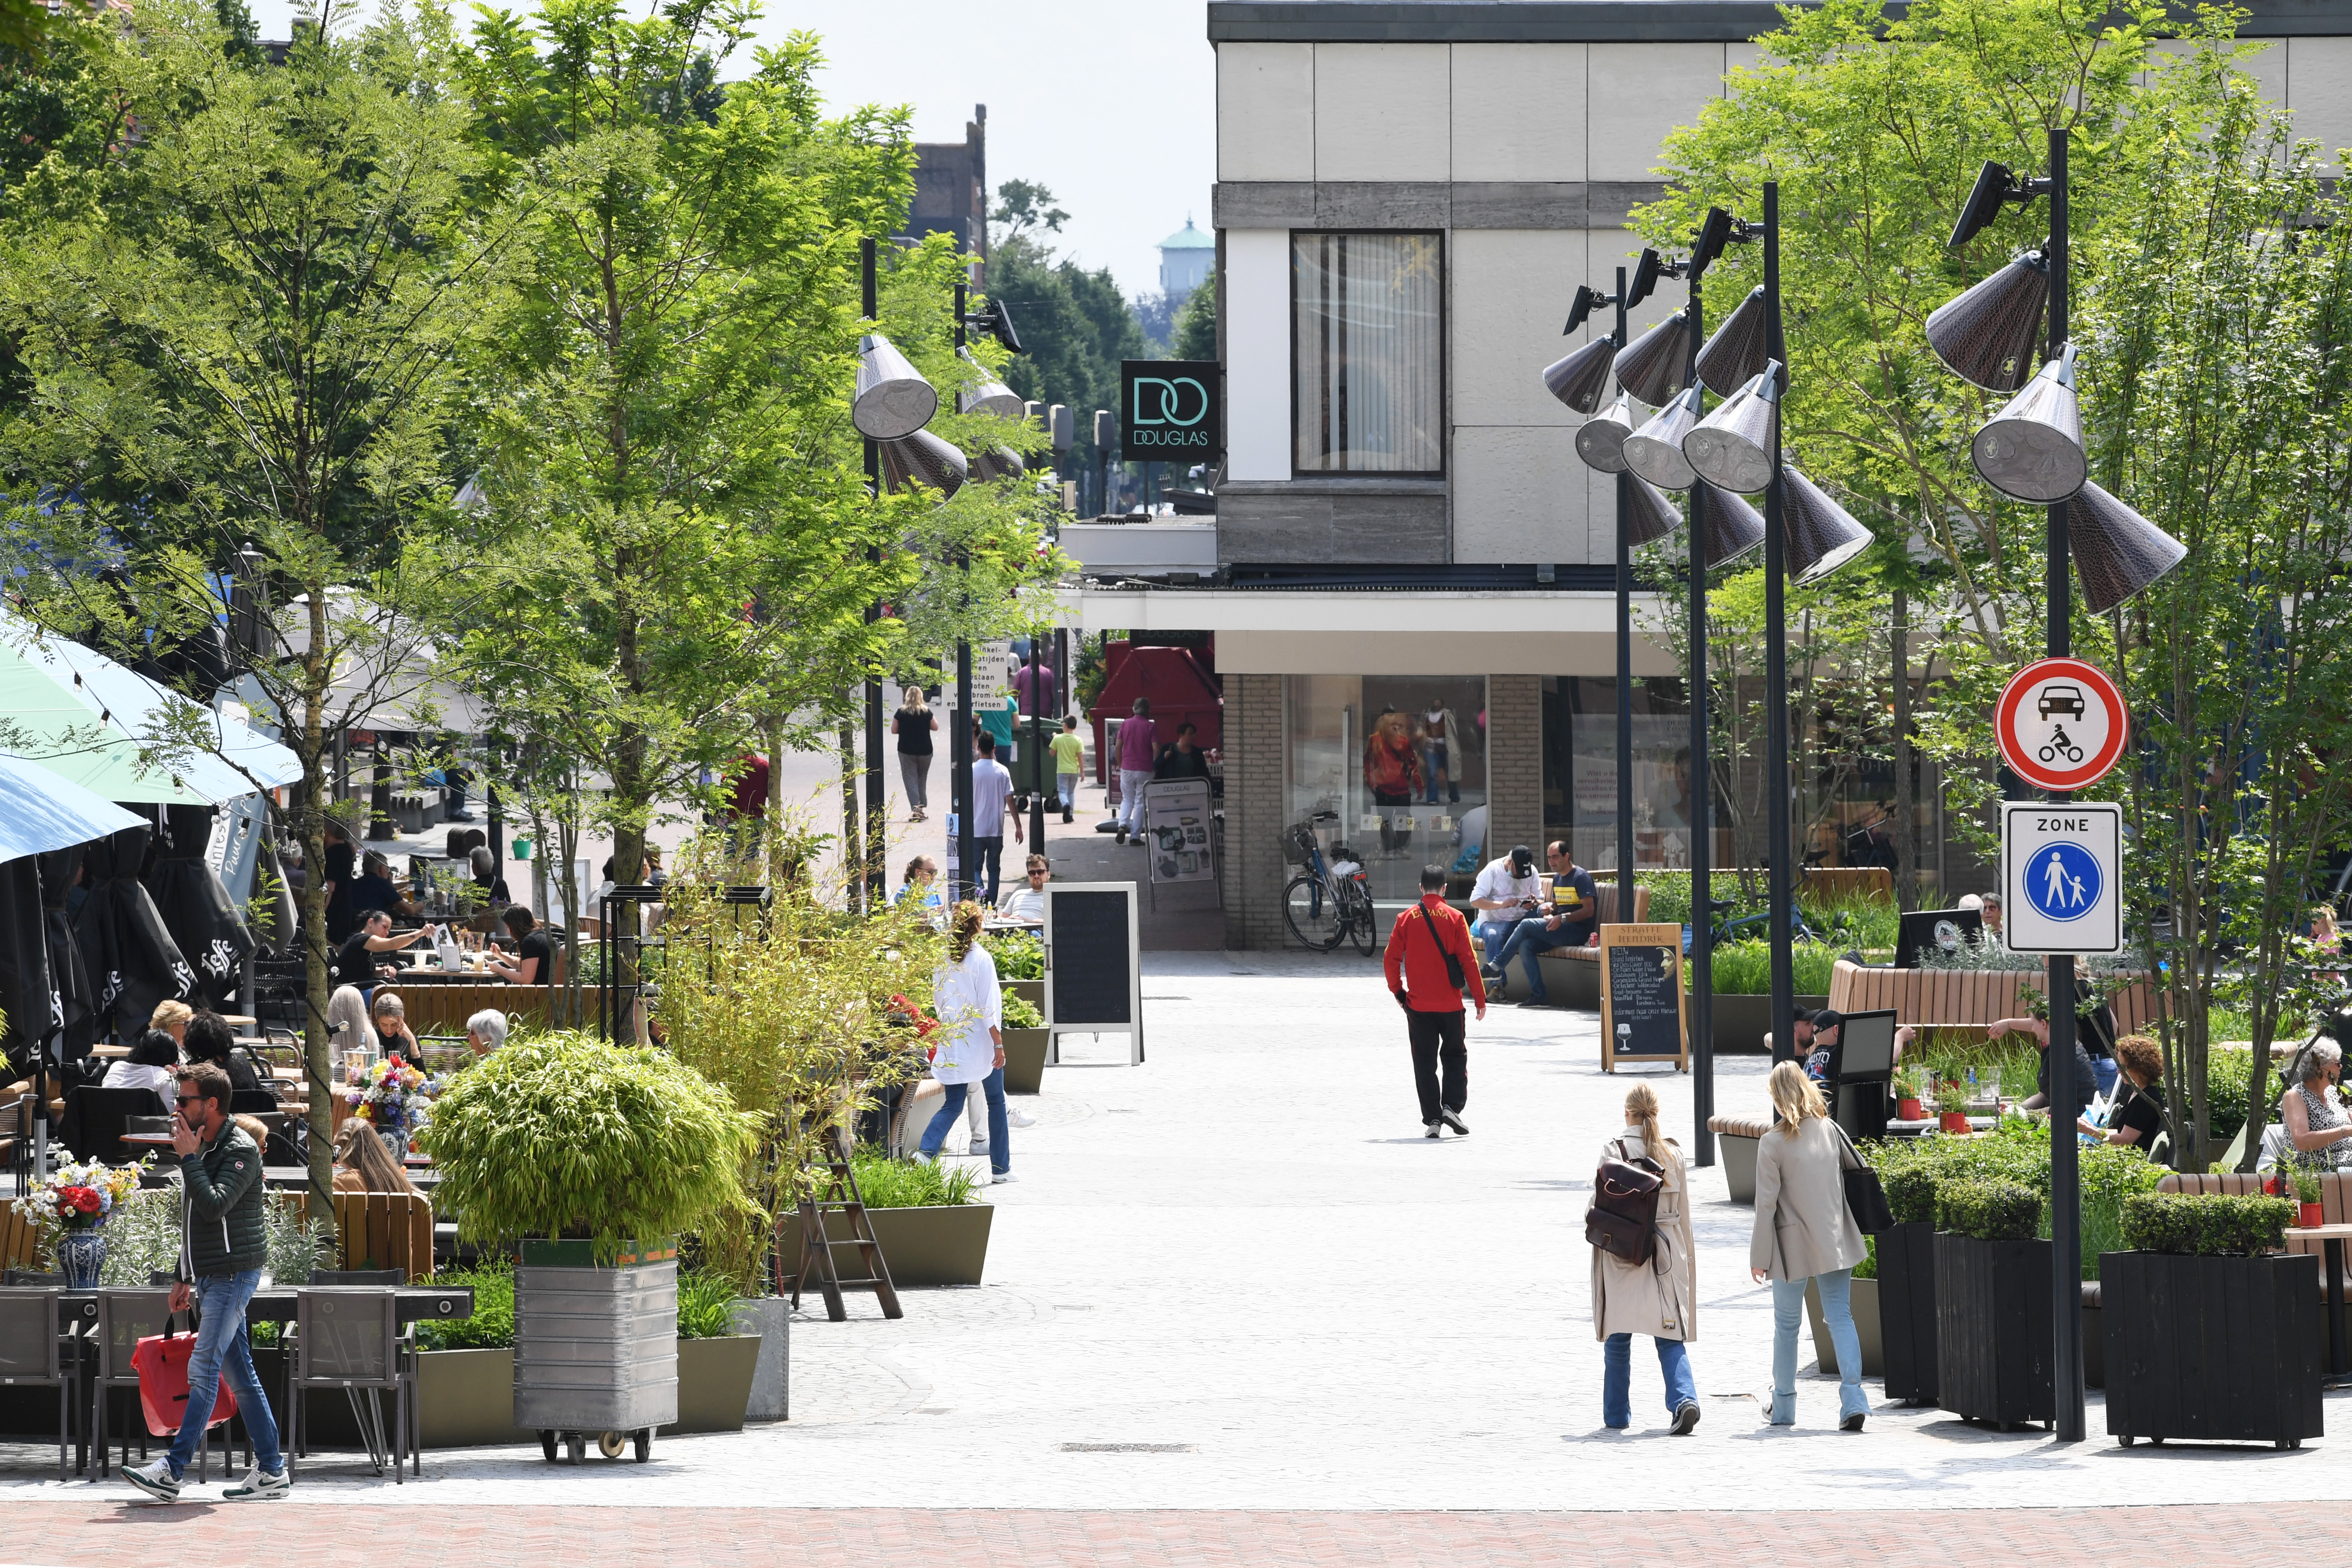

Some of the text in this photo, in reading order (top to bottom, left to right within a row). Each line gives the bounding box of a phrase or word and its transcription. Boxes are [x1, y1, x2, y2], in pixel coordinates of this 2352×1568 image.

[1134, 430, 1208, 446] DOUGLAS
[2037, 819, 2088, 831] ZONE
[225, 837, 241, 875] Puur
[1619, 934, 1666, 943] HENDRIK
[1612, 947, 1629, 955] NIEUW
[201, 939, 232, 979] Leffe
